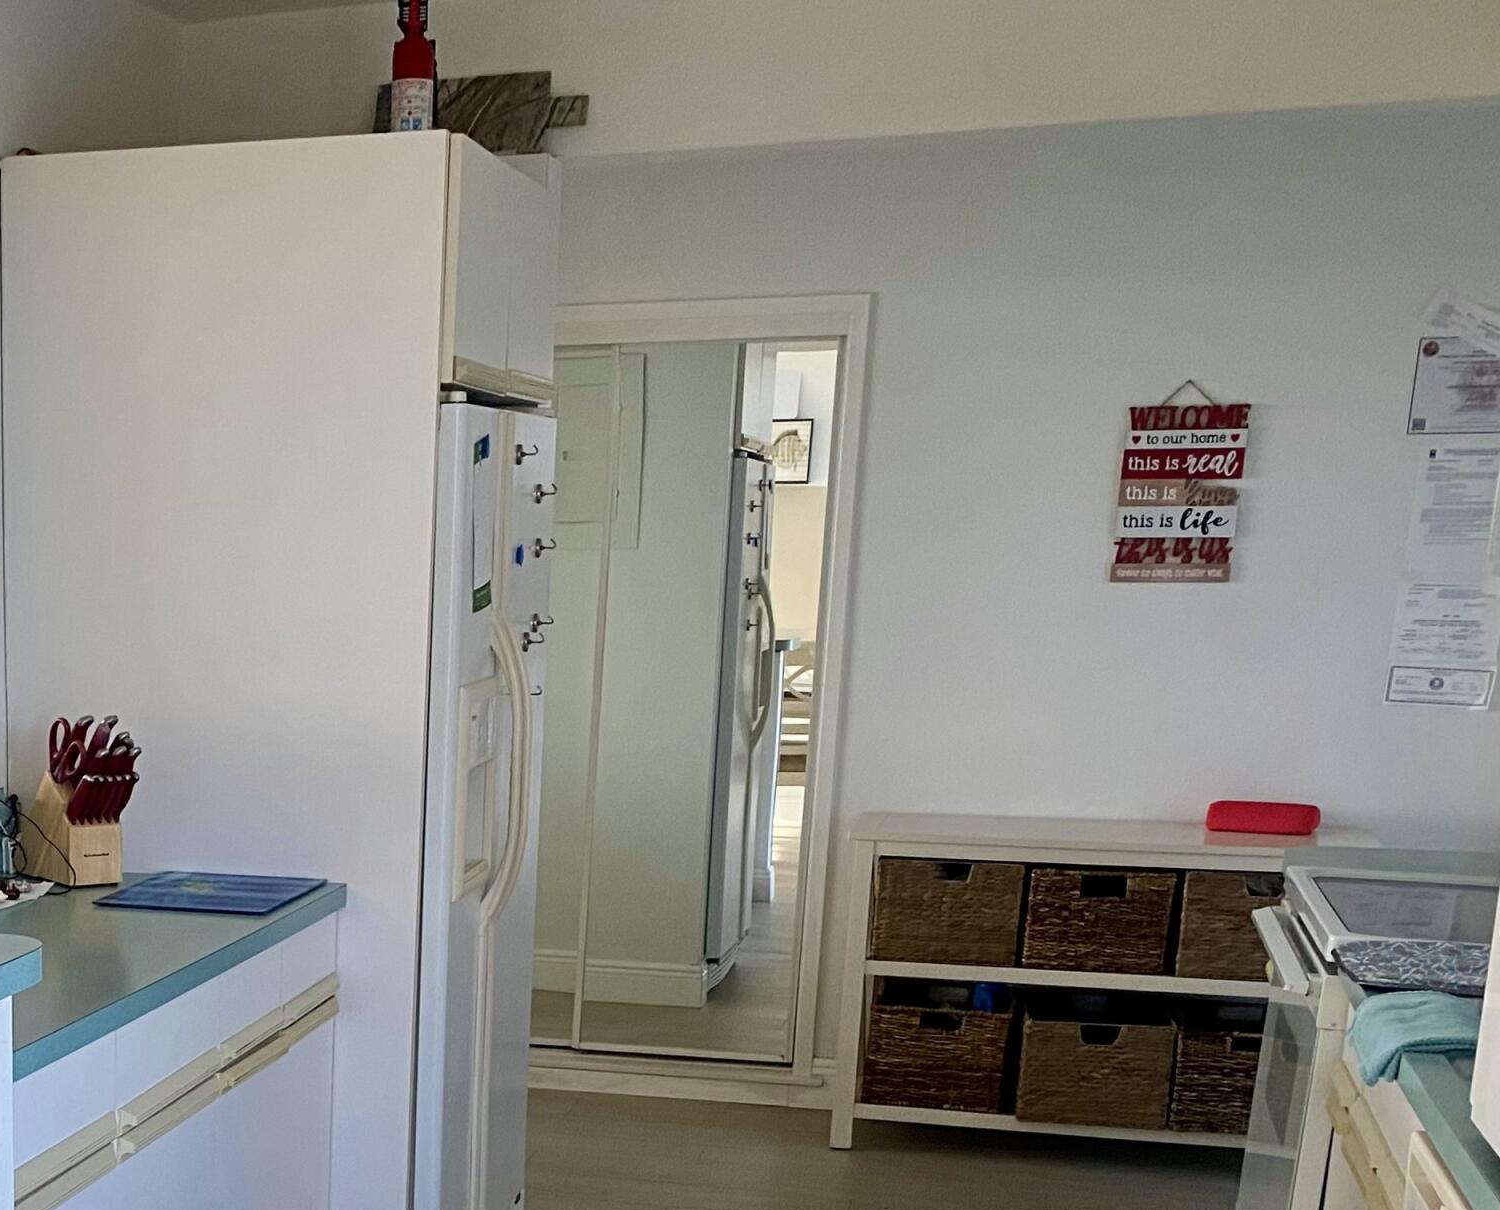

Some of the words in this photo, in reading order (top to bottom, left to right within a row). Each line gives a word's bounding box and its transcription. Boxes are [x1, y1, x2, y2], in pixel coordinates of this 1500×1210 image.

[1129, 404, 1252, 431] WELCOME
[1146, 433, 1159, 445] to
[1162, 434, 1187, 445] our
[1190, 432, 1227, 444] home
[1128, 456, 1160, 471] this
[1165, 455, 1180, 471] is
[1182, 450, 1239, 477] real
[1125, 486, 1157, 500] this
[1162, 485, 1177, 500] is
[1123, 514, 1154, 528] this
[1159, 513, 1173, 528] is
[1179, 507, 1229, 535] life
